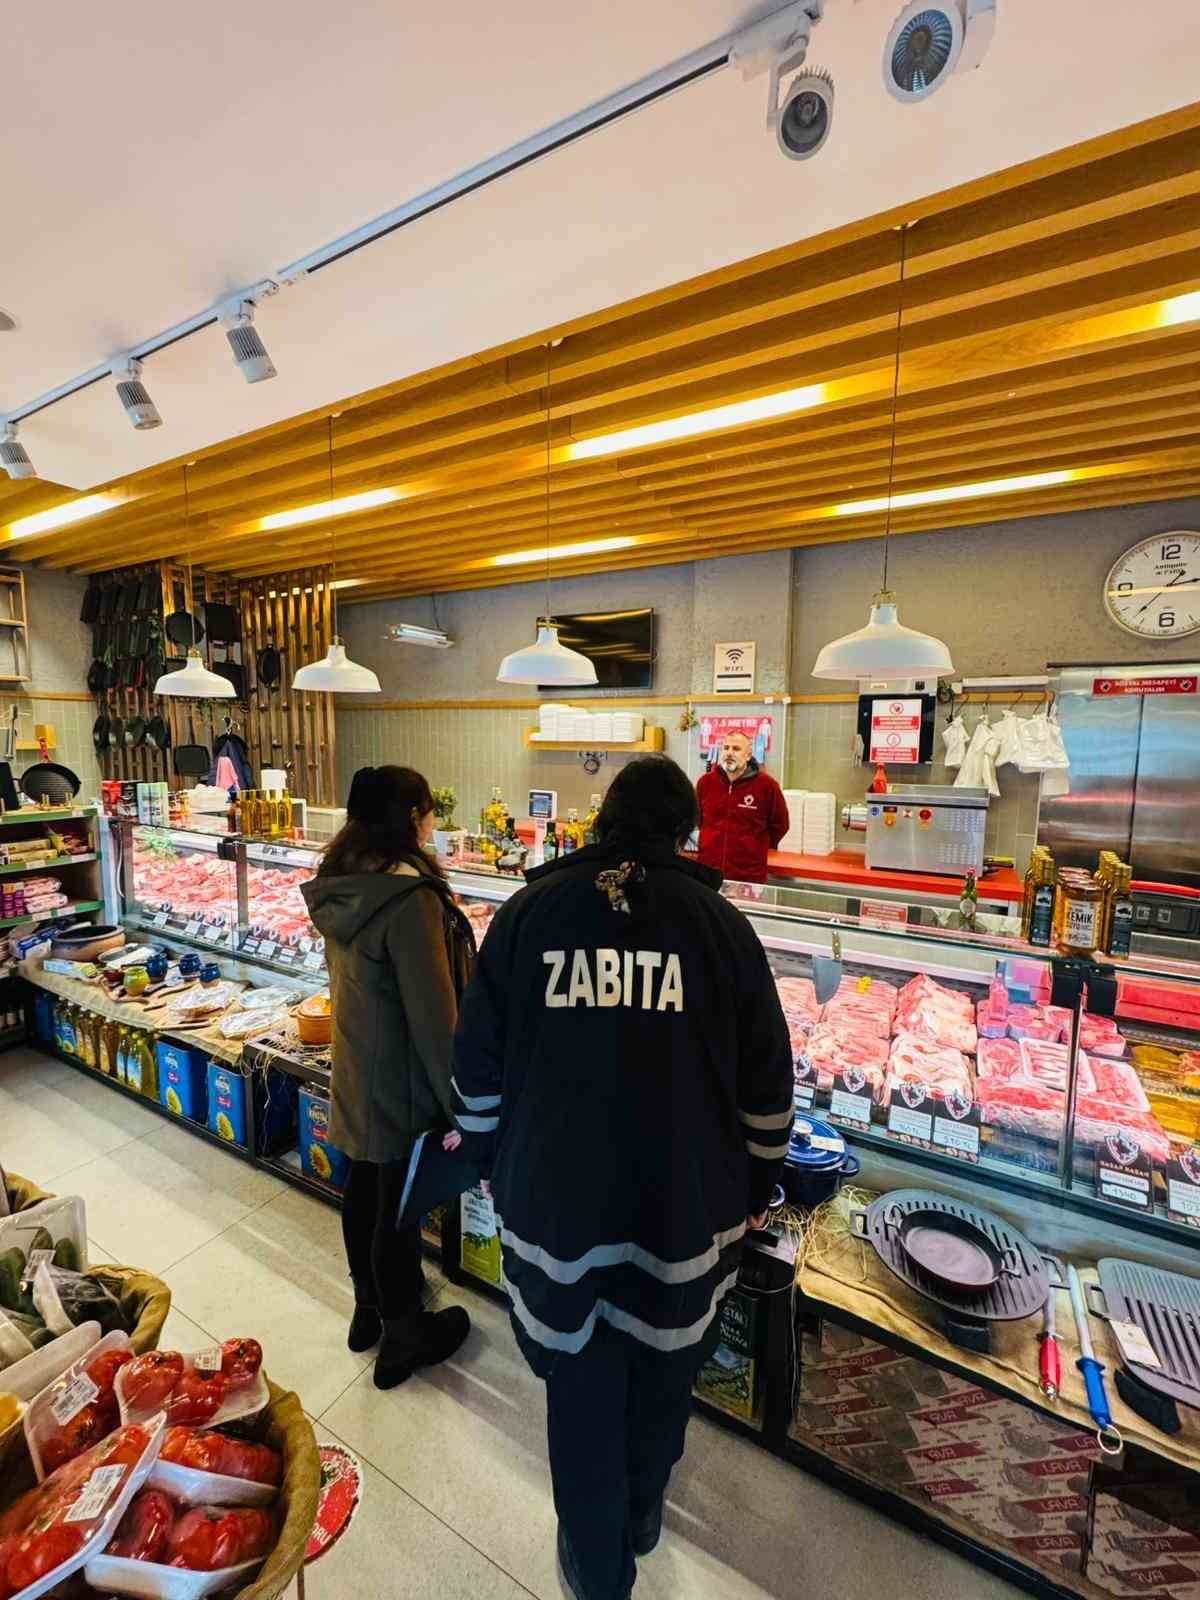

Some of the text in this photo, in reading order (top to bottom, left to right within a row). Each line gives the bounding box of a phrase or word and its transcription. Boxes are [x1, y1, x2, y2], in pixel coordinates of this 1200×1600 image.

[1161, 544, 1181, 560] 12
[1158, 612, 1175, 627] 6
[542, 948, 683, 1012] ZABITA
